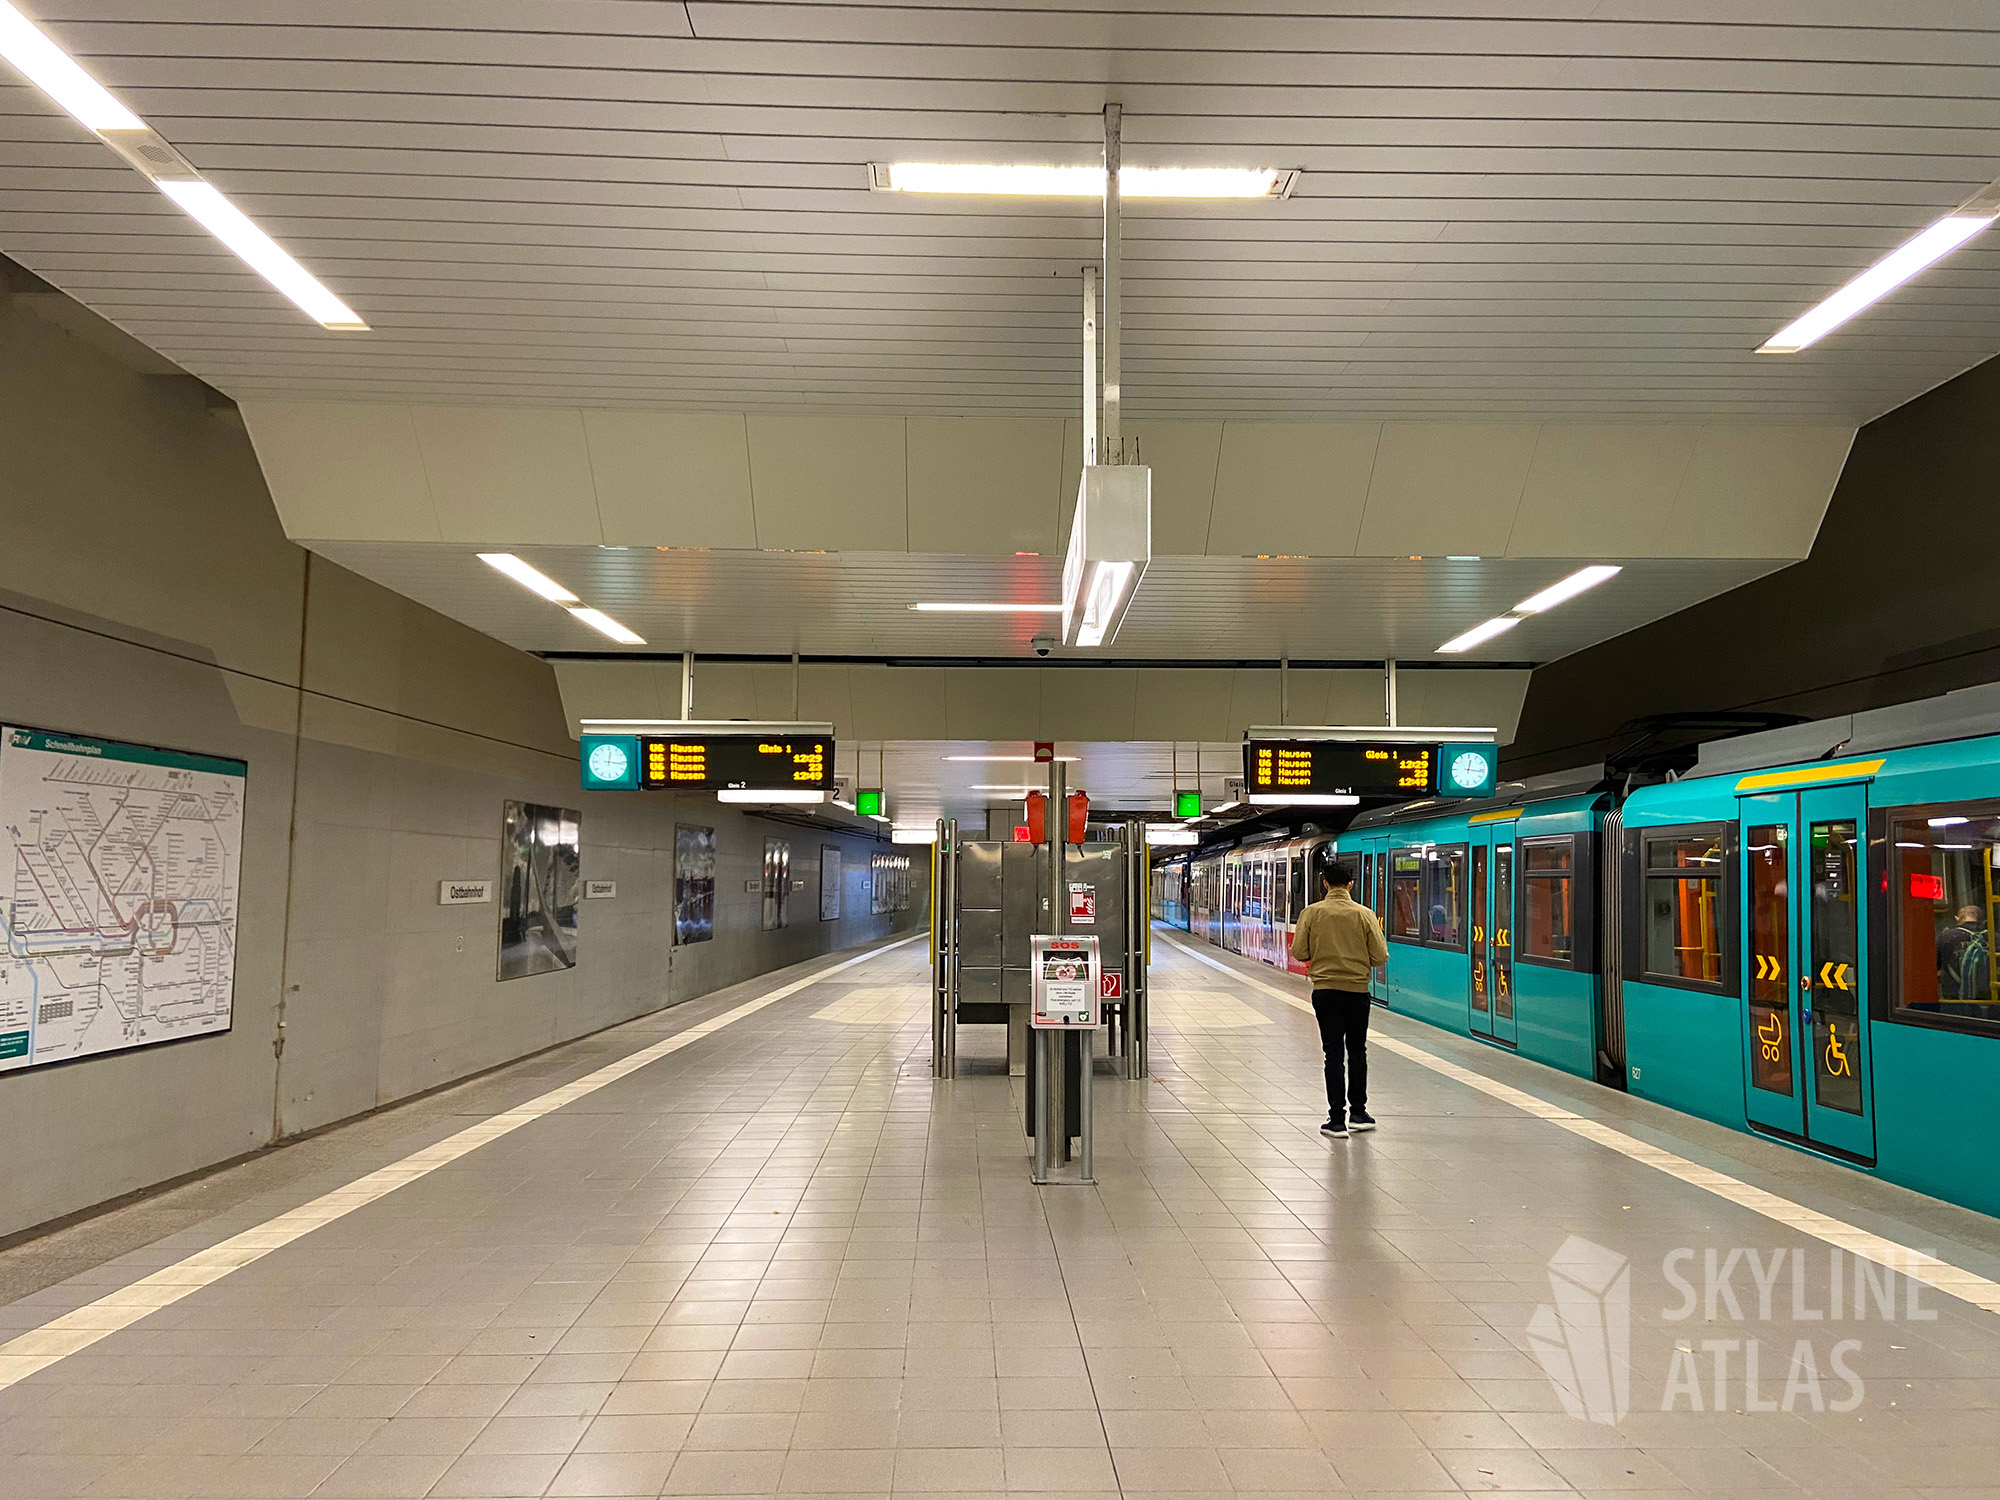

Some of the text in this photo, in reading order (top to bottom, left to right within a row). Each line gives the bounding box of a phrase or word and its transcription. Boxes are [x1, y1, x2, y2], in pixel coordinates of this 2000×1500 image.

[44, 738, 102, 755] Schnellbahnplan
[649, 743, 823, 754] U6 Hausen Gleis 1 3
[649, 753, 823, 763] U6 Hausen 12:29
[1258, 748, 1429, 760] U6 Hausen Gleis 1 3
[649, 762, 823, 772] U6 Hausen 23
[1258, 758, 1429, 769] U6 Hausen 12:29
[649, 771, 823, 781] U6 Hausen 12:49
[1258, 767, 1428, 778] U6 Hausen 23
[740, 781, 746, 789] 2
[1229, 780, 1244, 788] Gleis
[1257, 776, 1428, 786] U6 Hausen 12:49
[832, 787, 840, 800] 2
[1232, 788, 1239, 801] 1
[1347, 786, 1352, 794] 1
[450, 885, 484, 900] Ostbahnhof
[1050, 941, 1080, 950] SOS
